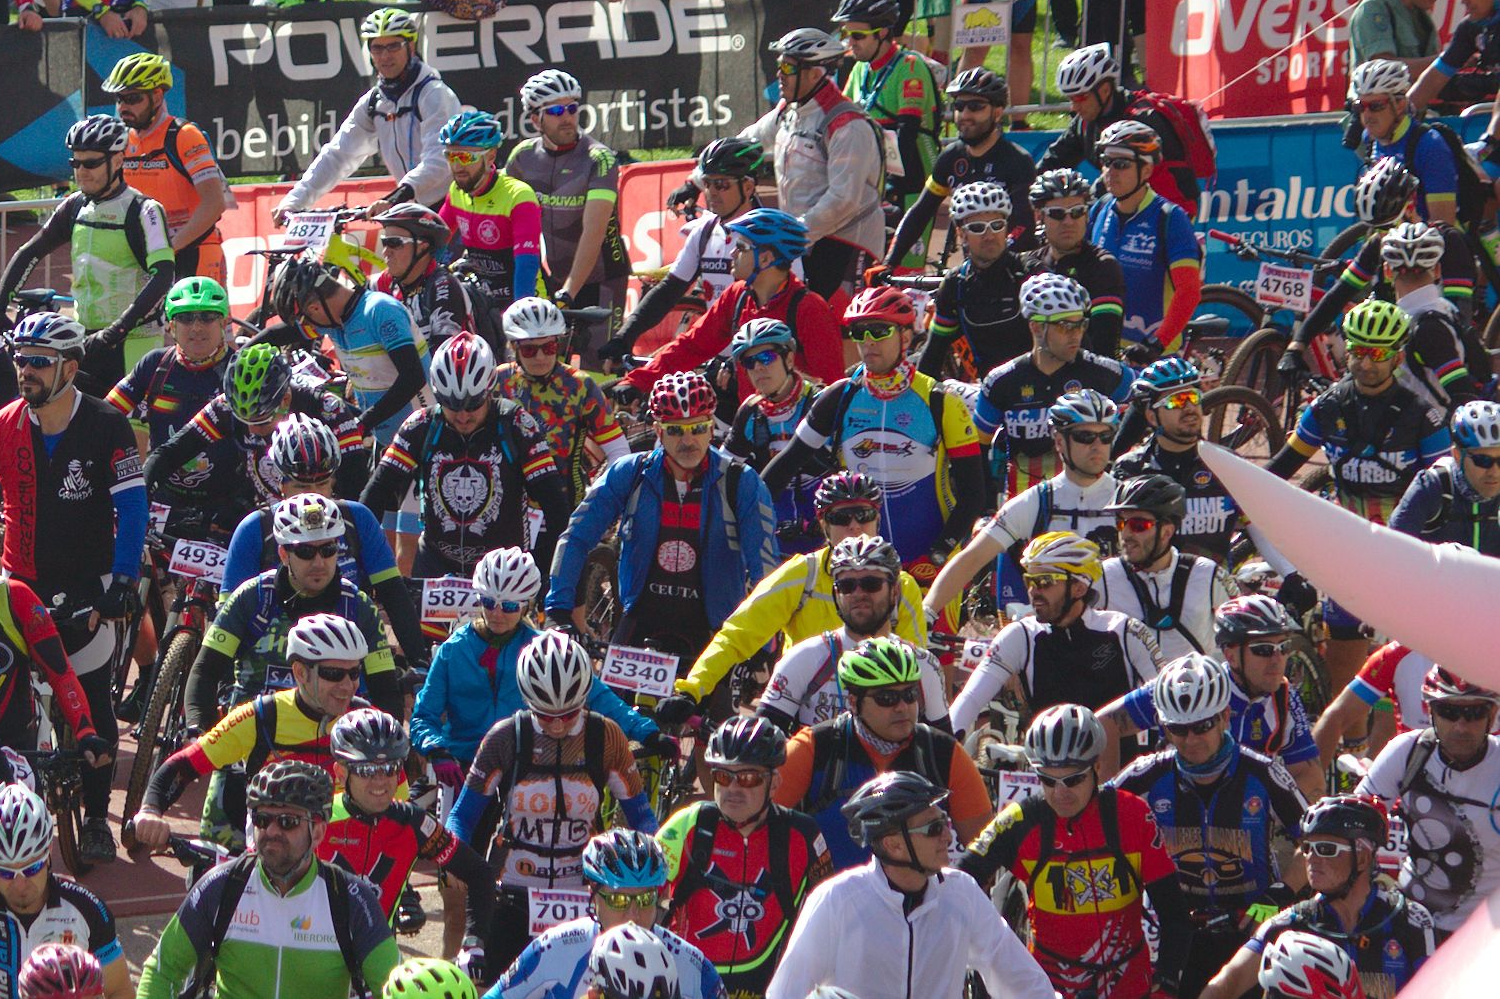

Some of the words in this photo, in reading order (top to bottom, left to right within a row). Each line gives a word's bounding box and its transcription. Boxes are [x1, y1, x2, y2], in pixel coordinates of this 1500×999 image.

[213, 107, 340, 161] bebid
[496, 89, 732, 153] deortistas
[1197, 175, 1358, 224] ntaluc
[289, 224, 326, 238] 4871
[1260, 276, 1304, 298] 4768
[116, 465, 142, 478] DESER
[649, 582, 699, 599] CEUTA
[608, 659, 668, 683] 5340
[222, 707, 255, 732] LEGIO
[514, 817, 589, 844] MTB
[234, 909, 260, 925] lub
[293, 931, 338, 945] IBERDRO
